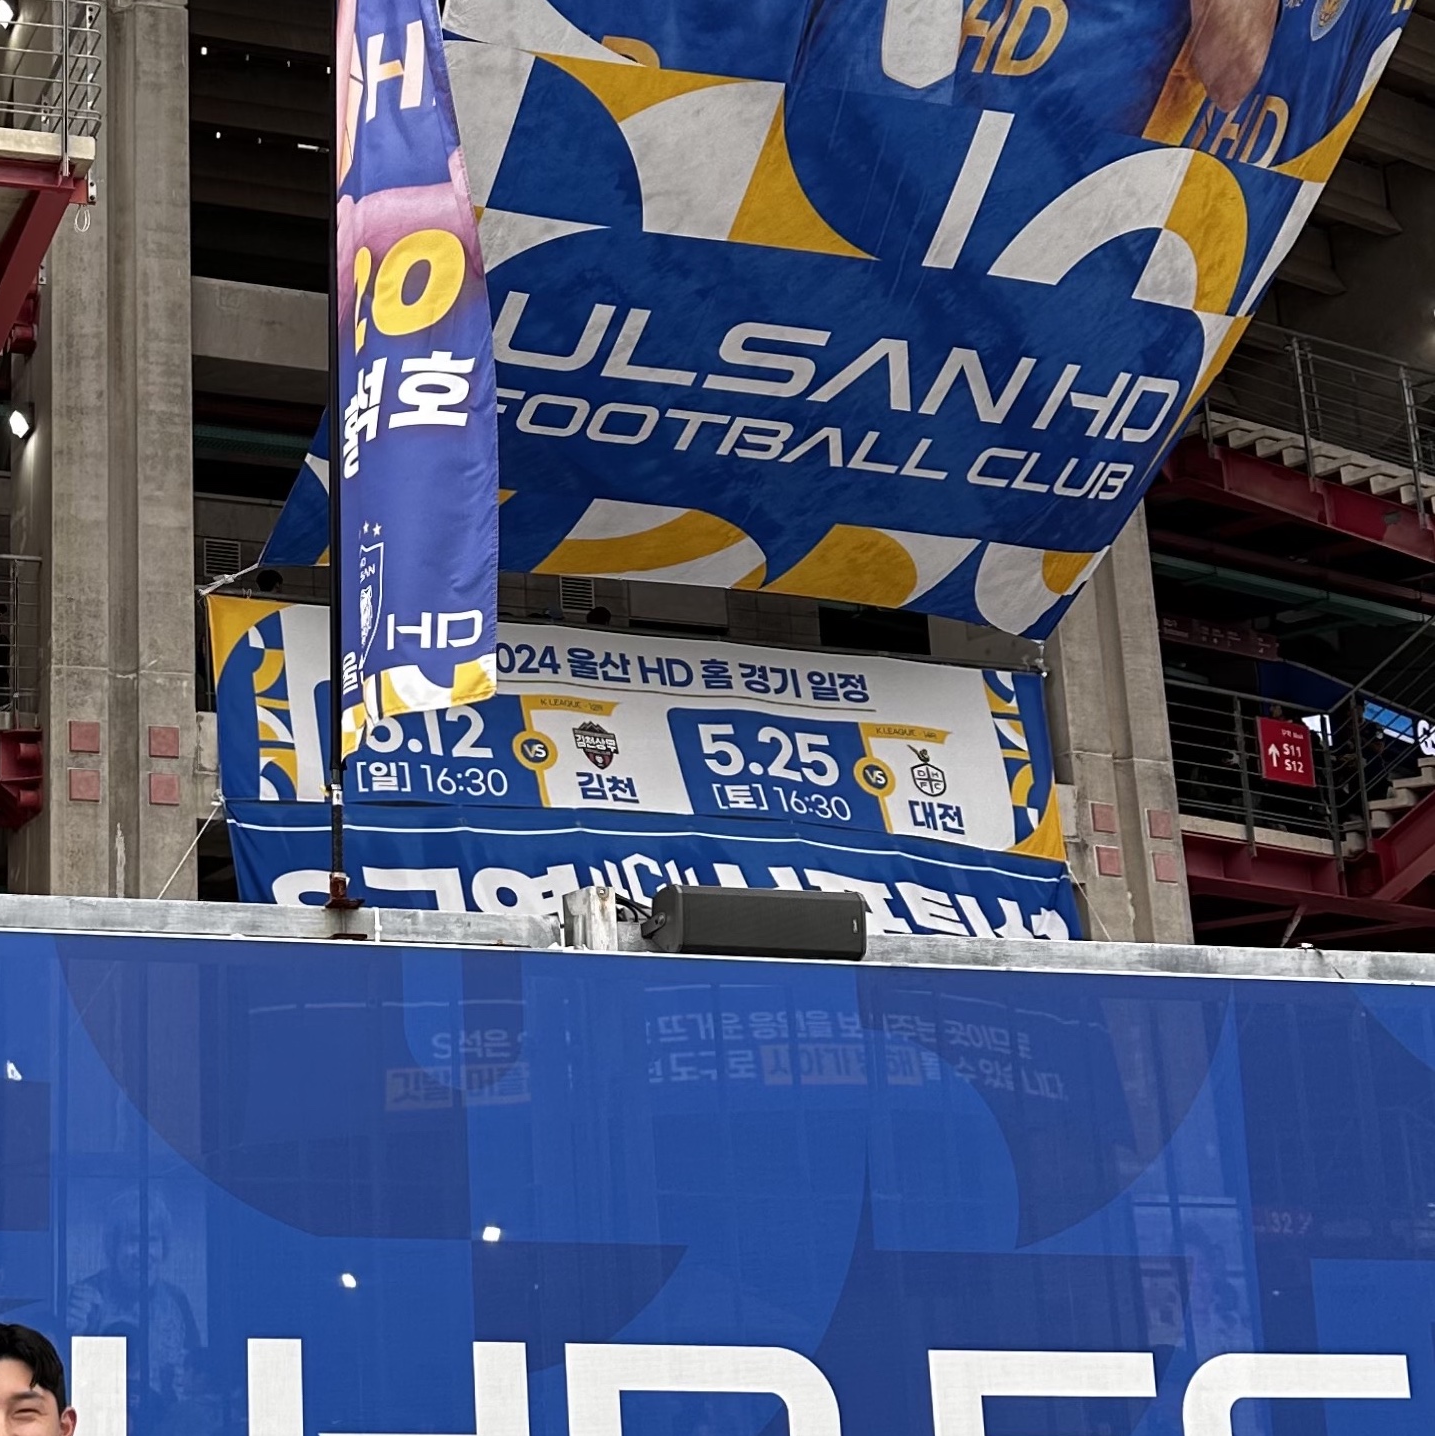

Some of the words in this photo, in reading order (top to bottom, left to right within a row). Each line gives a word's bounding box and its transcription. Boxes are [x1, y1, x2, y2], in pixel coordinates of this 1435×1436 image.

[493, 290, 1038, 424] ULSAN
[1030, 363, 1181, 443] HD
[966, 446, 1135, 501] CLUB
[386, 609, 484, 651] HD
[496, 642, 561, 675] 024
[566, 646, 631, 684] 울산
[637, 655, 694, 688] HD
[700, 657, 735, 690] 홈
[738, 661, 802, 699] 경기
[806, 670, 871, 704] 일정
[523, 743, 547, 758] VS
[574, 734, 617, 752] 김천상무
[697, 723, 840, 787] 5.25
[1282, 743, 1302, 758] S11
[356, 761, 412, 793] [일]
[420, 765, 509, 797] 16:30
[865, 767, 887, 785] VS
[1284, 758, 1305, 773] S12
[576, 771, 641, 804] 김천
[711, 783, 770, 812] [토]
[773, 786, 853, 822] 16:30
[908, 799, 966, 836] 대전
[837, 1011, 937, 1043] 보주는
